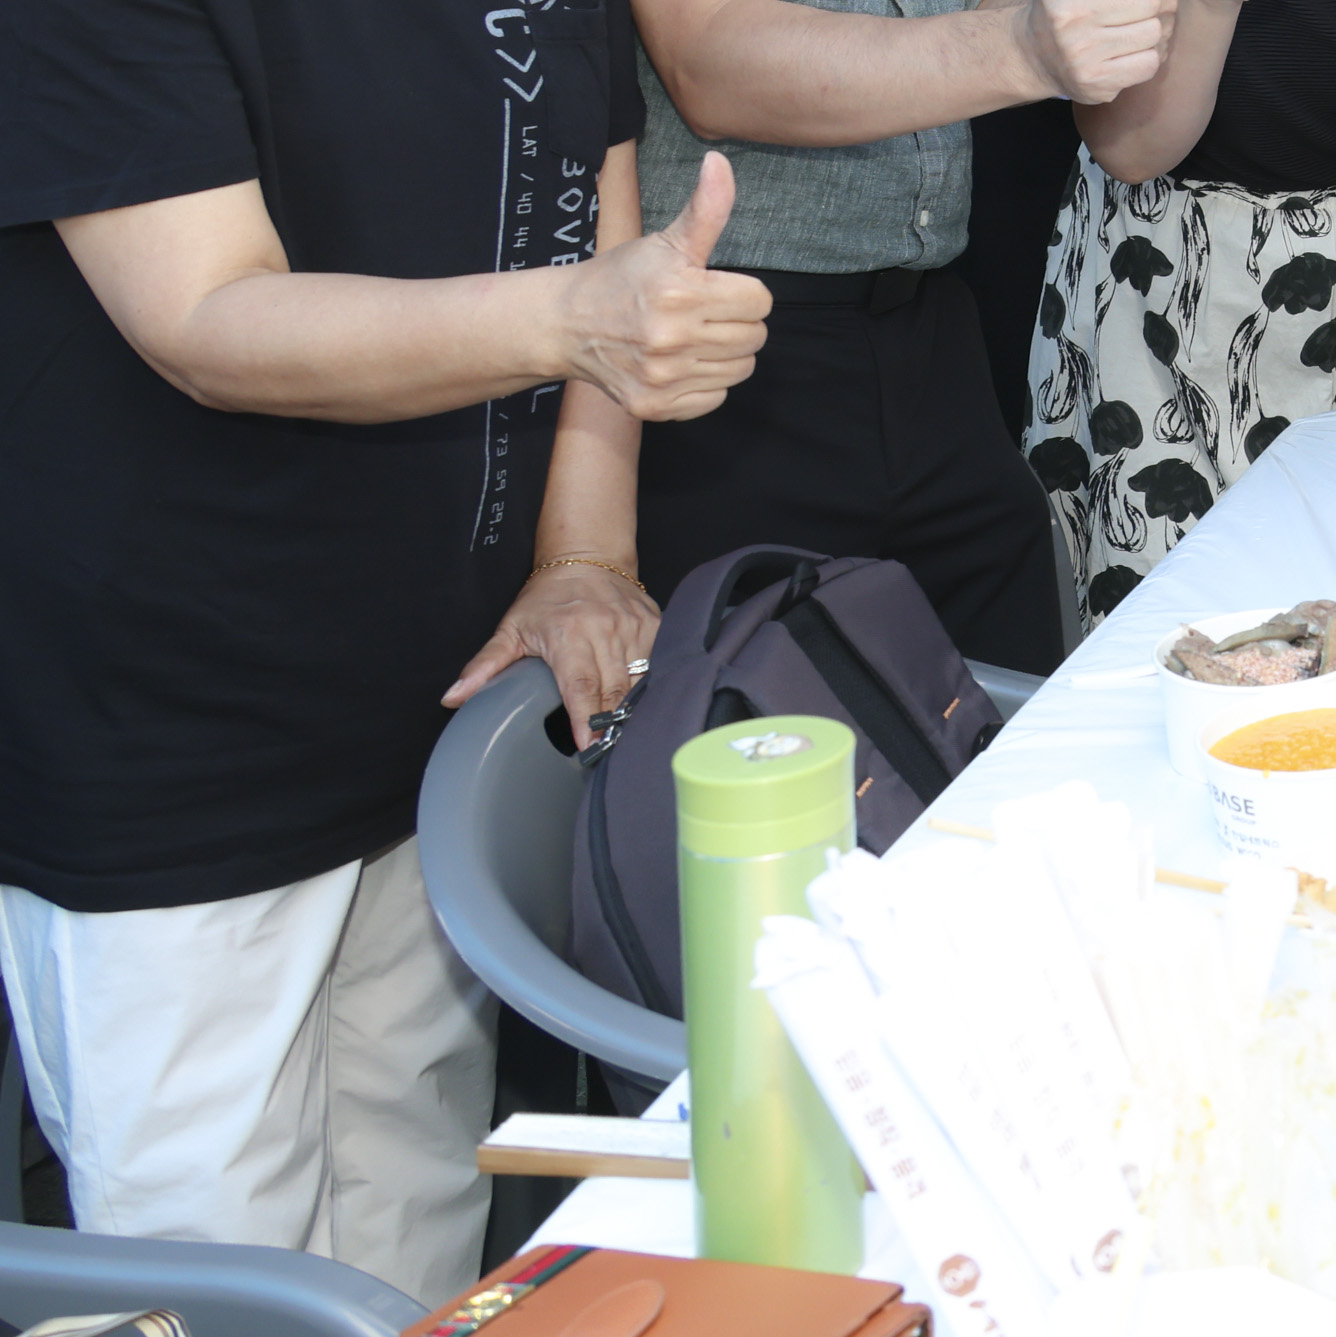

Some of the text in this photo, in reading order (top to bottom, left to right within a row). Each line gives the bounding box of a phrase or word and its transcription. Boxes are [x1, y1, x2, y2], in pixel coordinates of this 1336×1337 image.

[522, 125, 538, 157] LAT
[516, 192, 533, 215] 40
[512, 226, 530, 248] 44
[496, 433, 508, 457] 73
[495, 468, 507, 492] 59
[483, 501, 504, 546] 29.2
